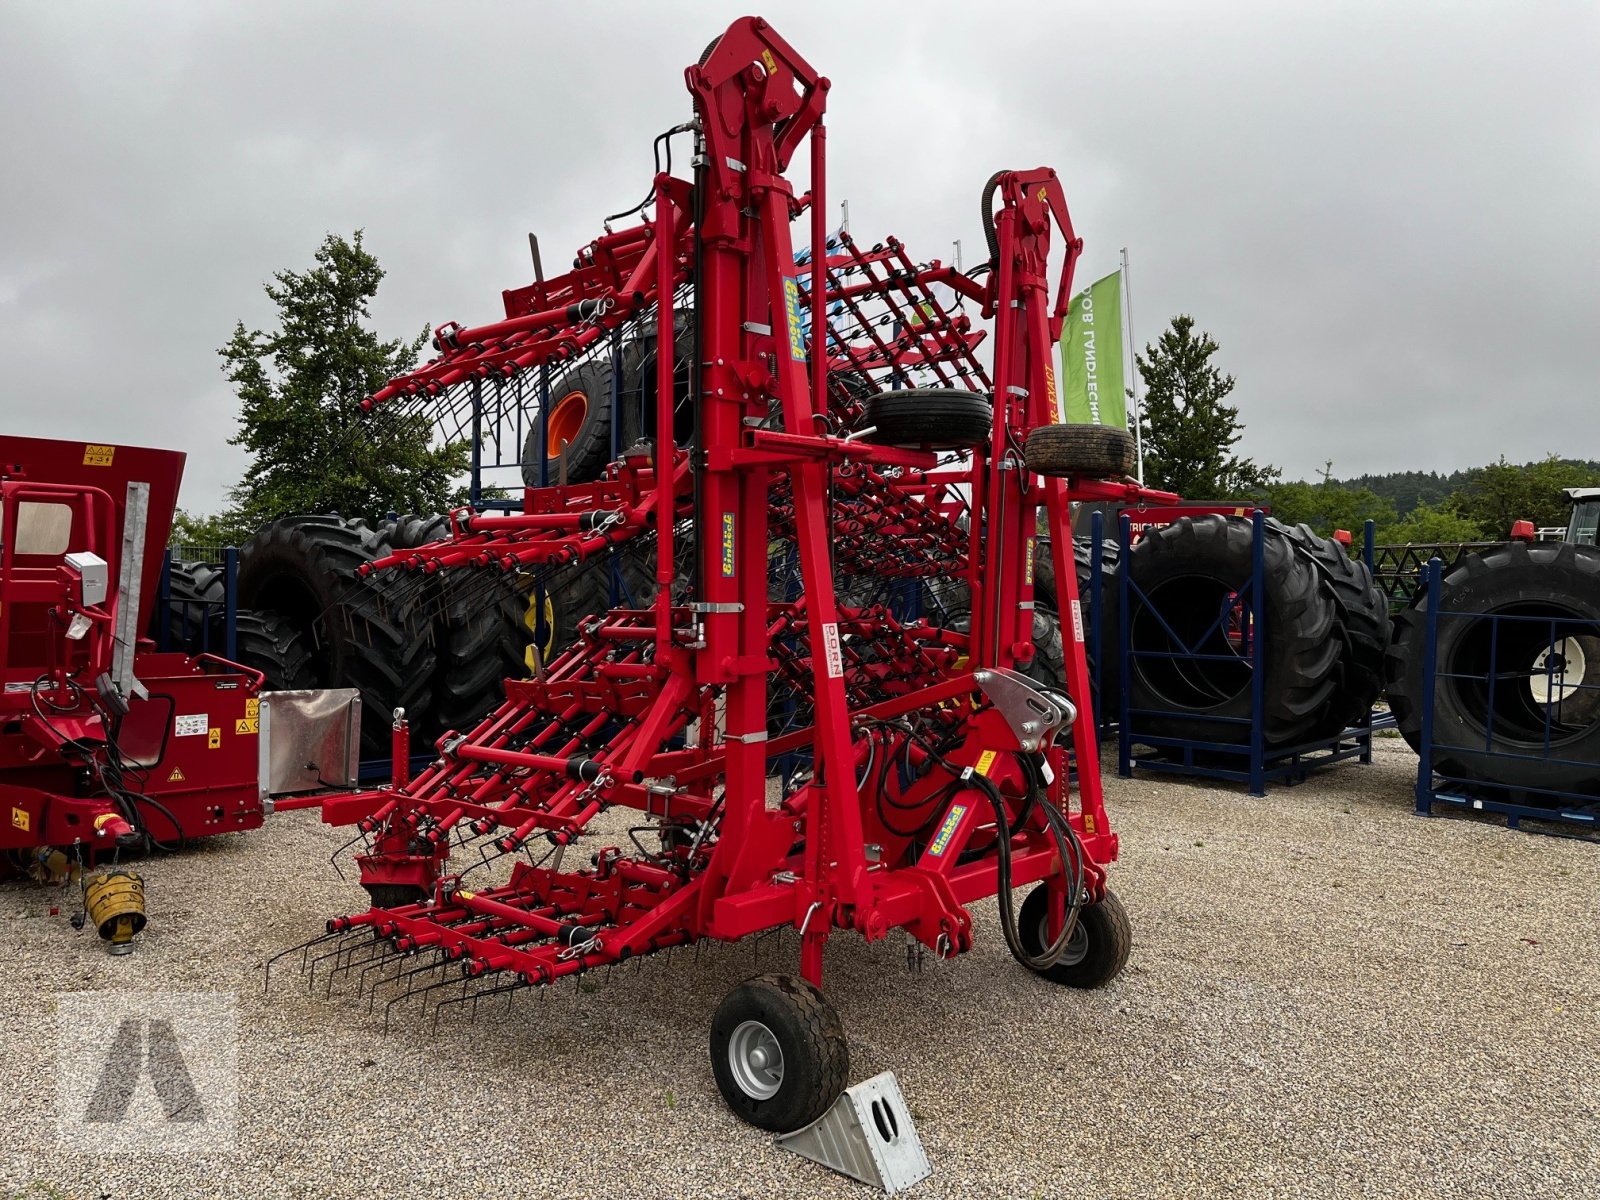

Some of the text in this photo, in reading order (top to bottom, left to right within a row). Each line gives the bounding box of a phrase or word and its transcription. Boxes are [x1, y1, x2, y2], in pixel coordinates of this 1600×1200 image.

[785, 280, 805, 359] Einböck
[722, 515, 733, 575] Einböck
[829, 625, 841, 675] DORN
[931, 806, 963, 854] Einböck
